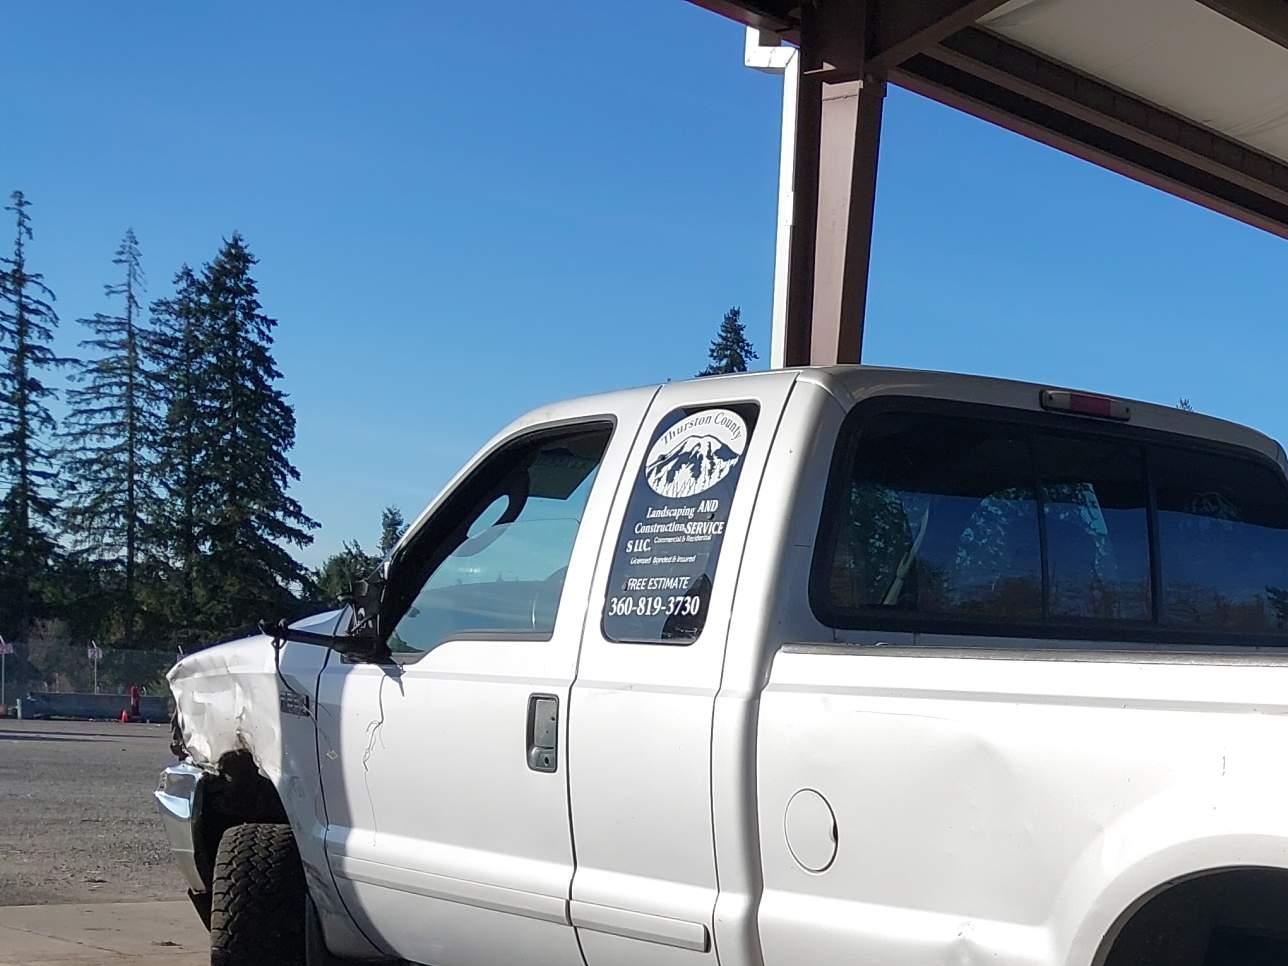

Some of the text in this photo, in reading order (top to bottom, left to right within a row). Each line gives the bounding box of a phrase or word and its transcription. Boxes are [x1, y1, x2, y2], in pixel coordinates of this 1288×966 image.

[661, 412, 742, 445] Thurston County
[646, 500, 719, 520] Landscaping AND
[634, 521, 725, 535] Construction SERVICE
[625, 540, 634, 553] S
[626, 576, 691, 591] FREE ESTIMATE
[608, 595, 700, 616] 360-819-3730
